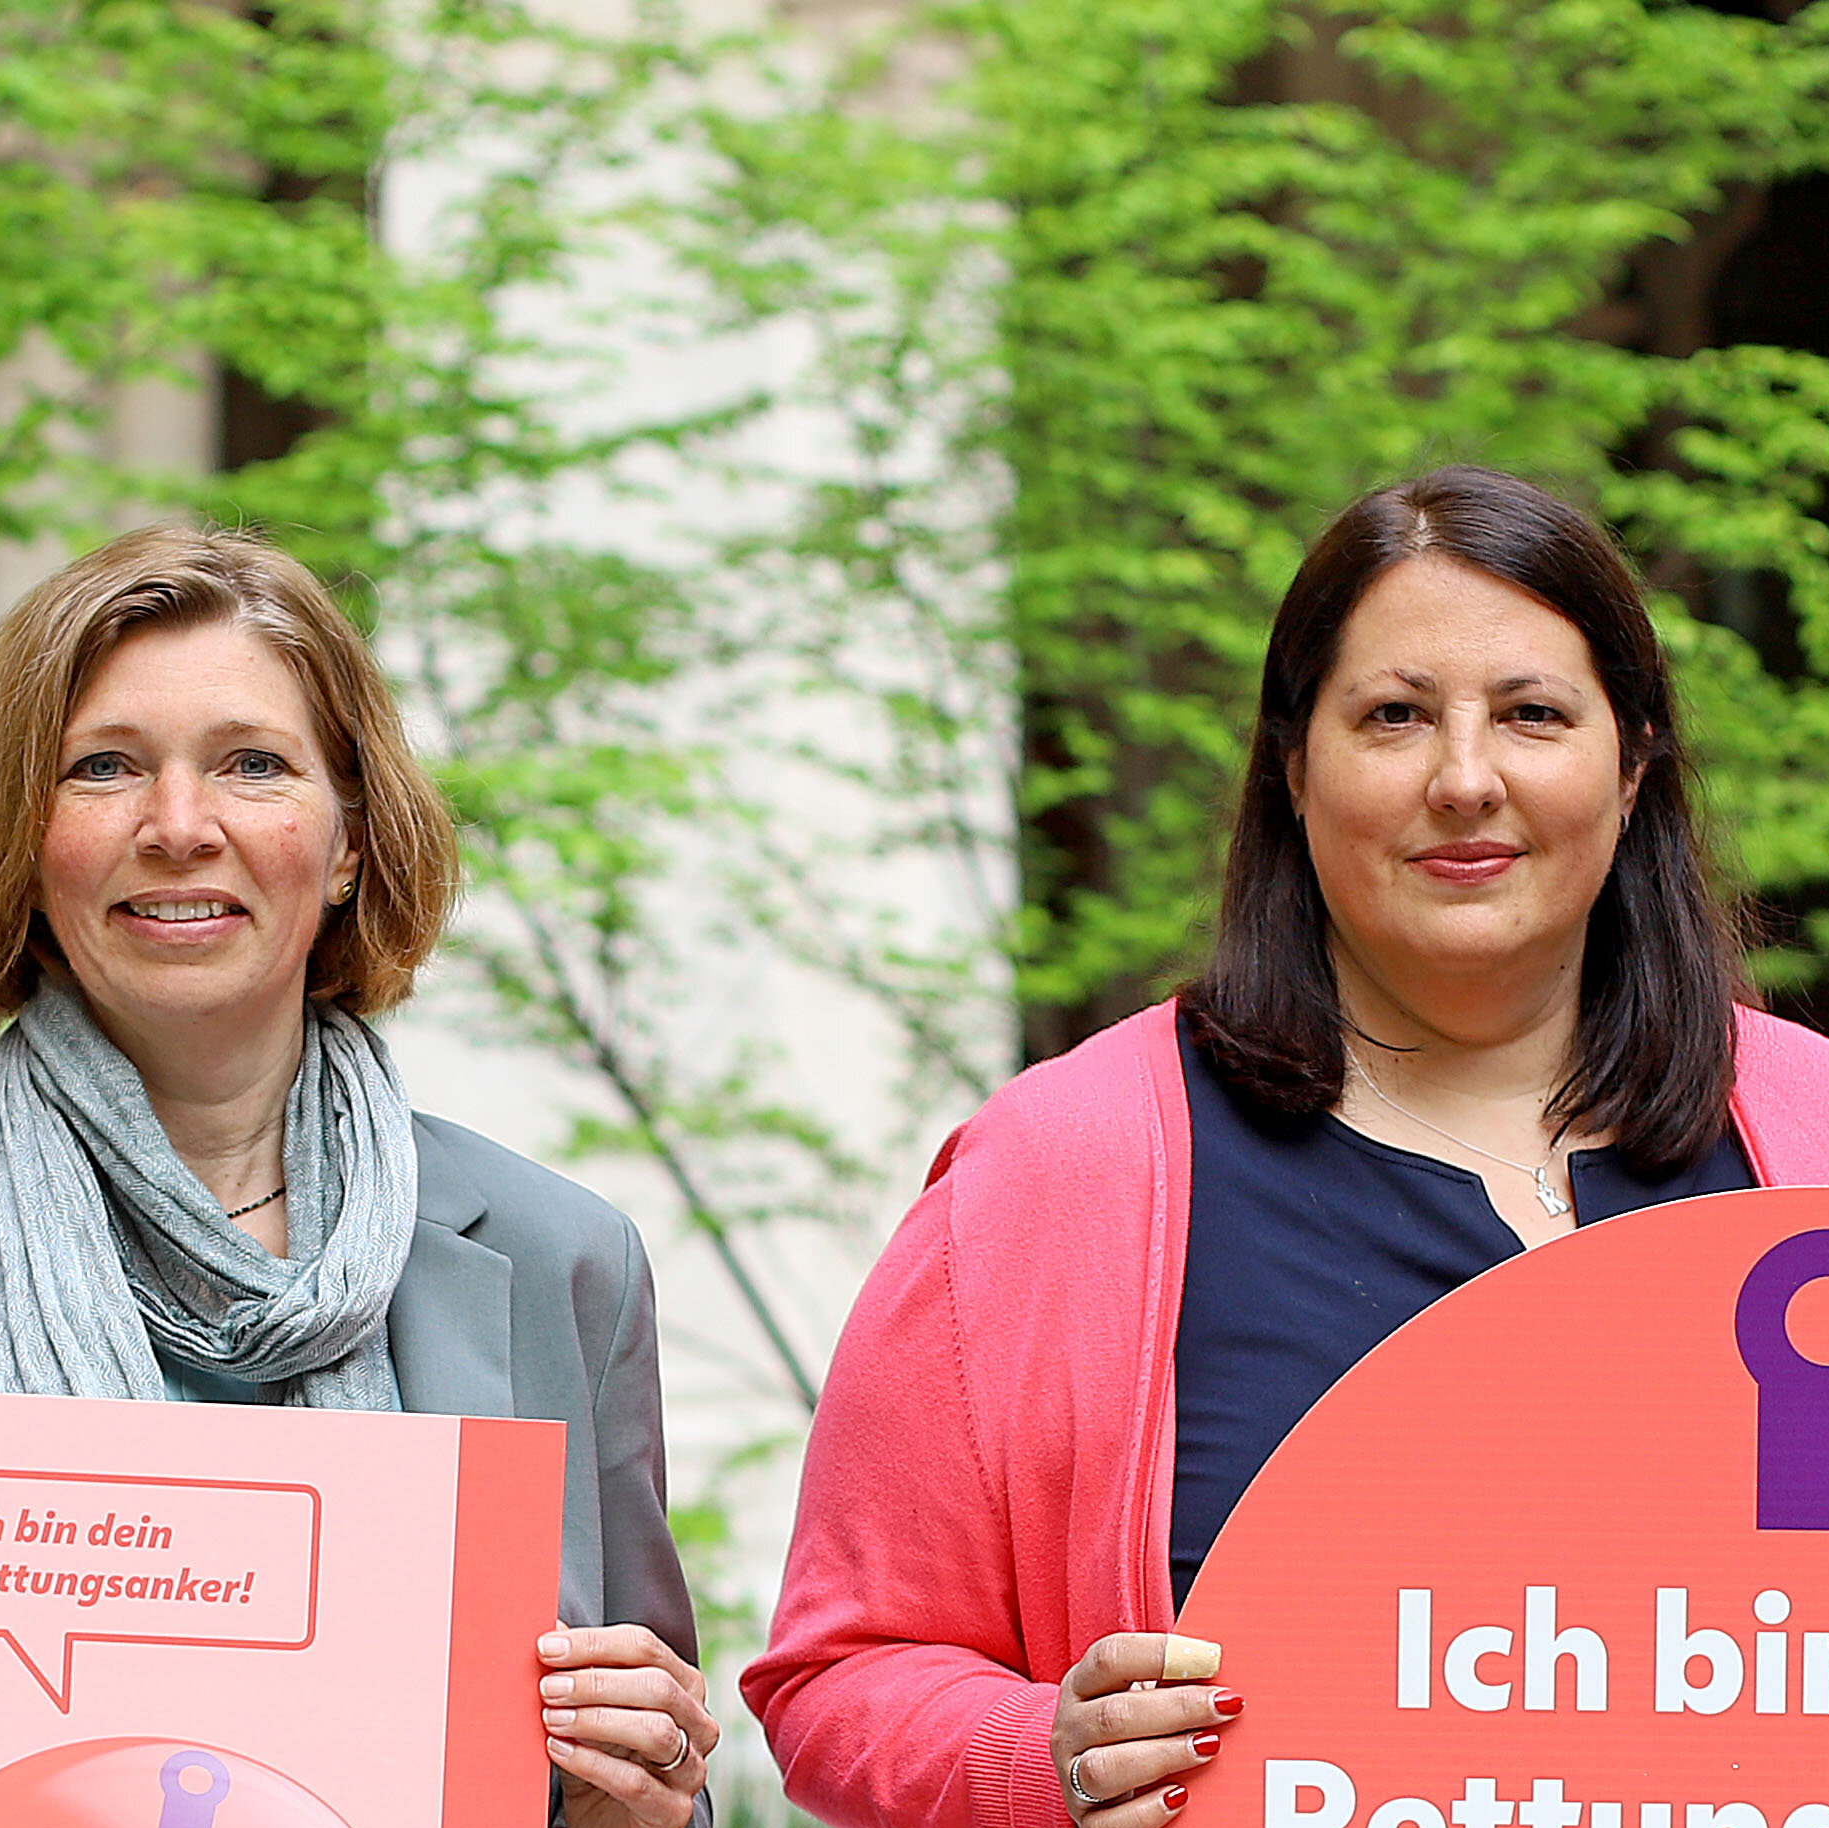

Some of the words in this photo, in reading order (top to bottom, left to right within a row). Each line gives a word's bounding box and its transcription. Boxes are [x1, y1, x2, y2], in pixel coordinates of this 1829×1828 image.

[17, 1509, 77, 1545] bin
[87, 1512, 173, 1549] dein
[1397, 1585, 1608, 1712] Ich
